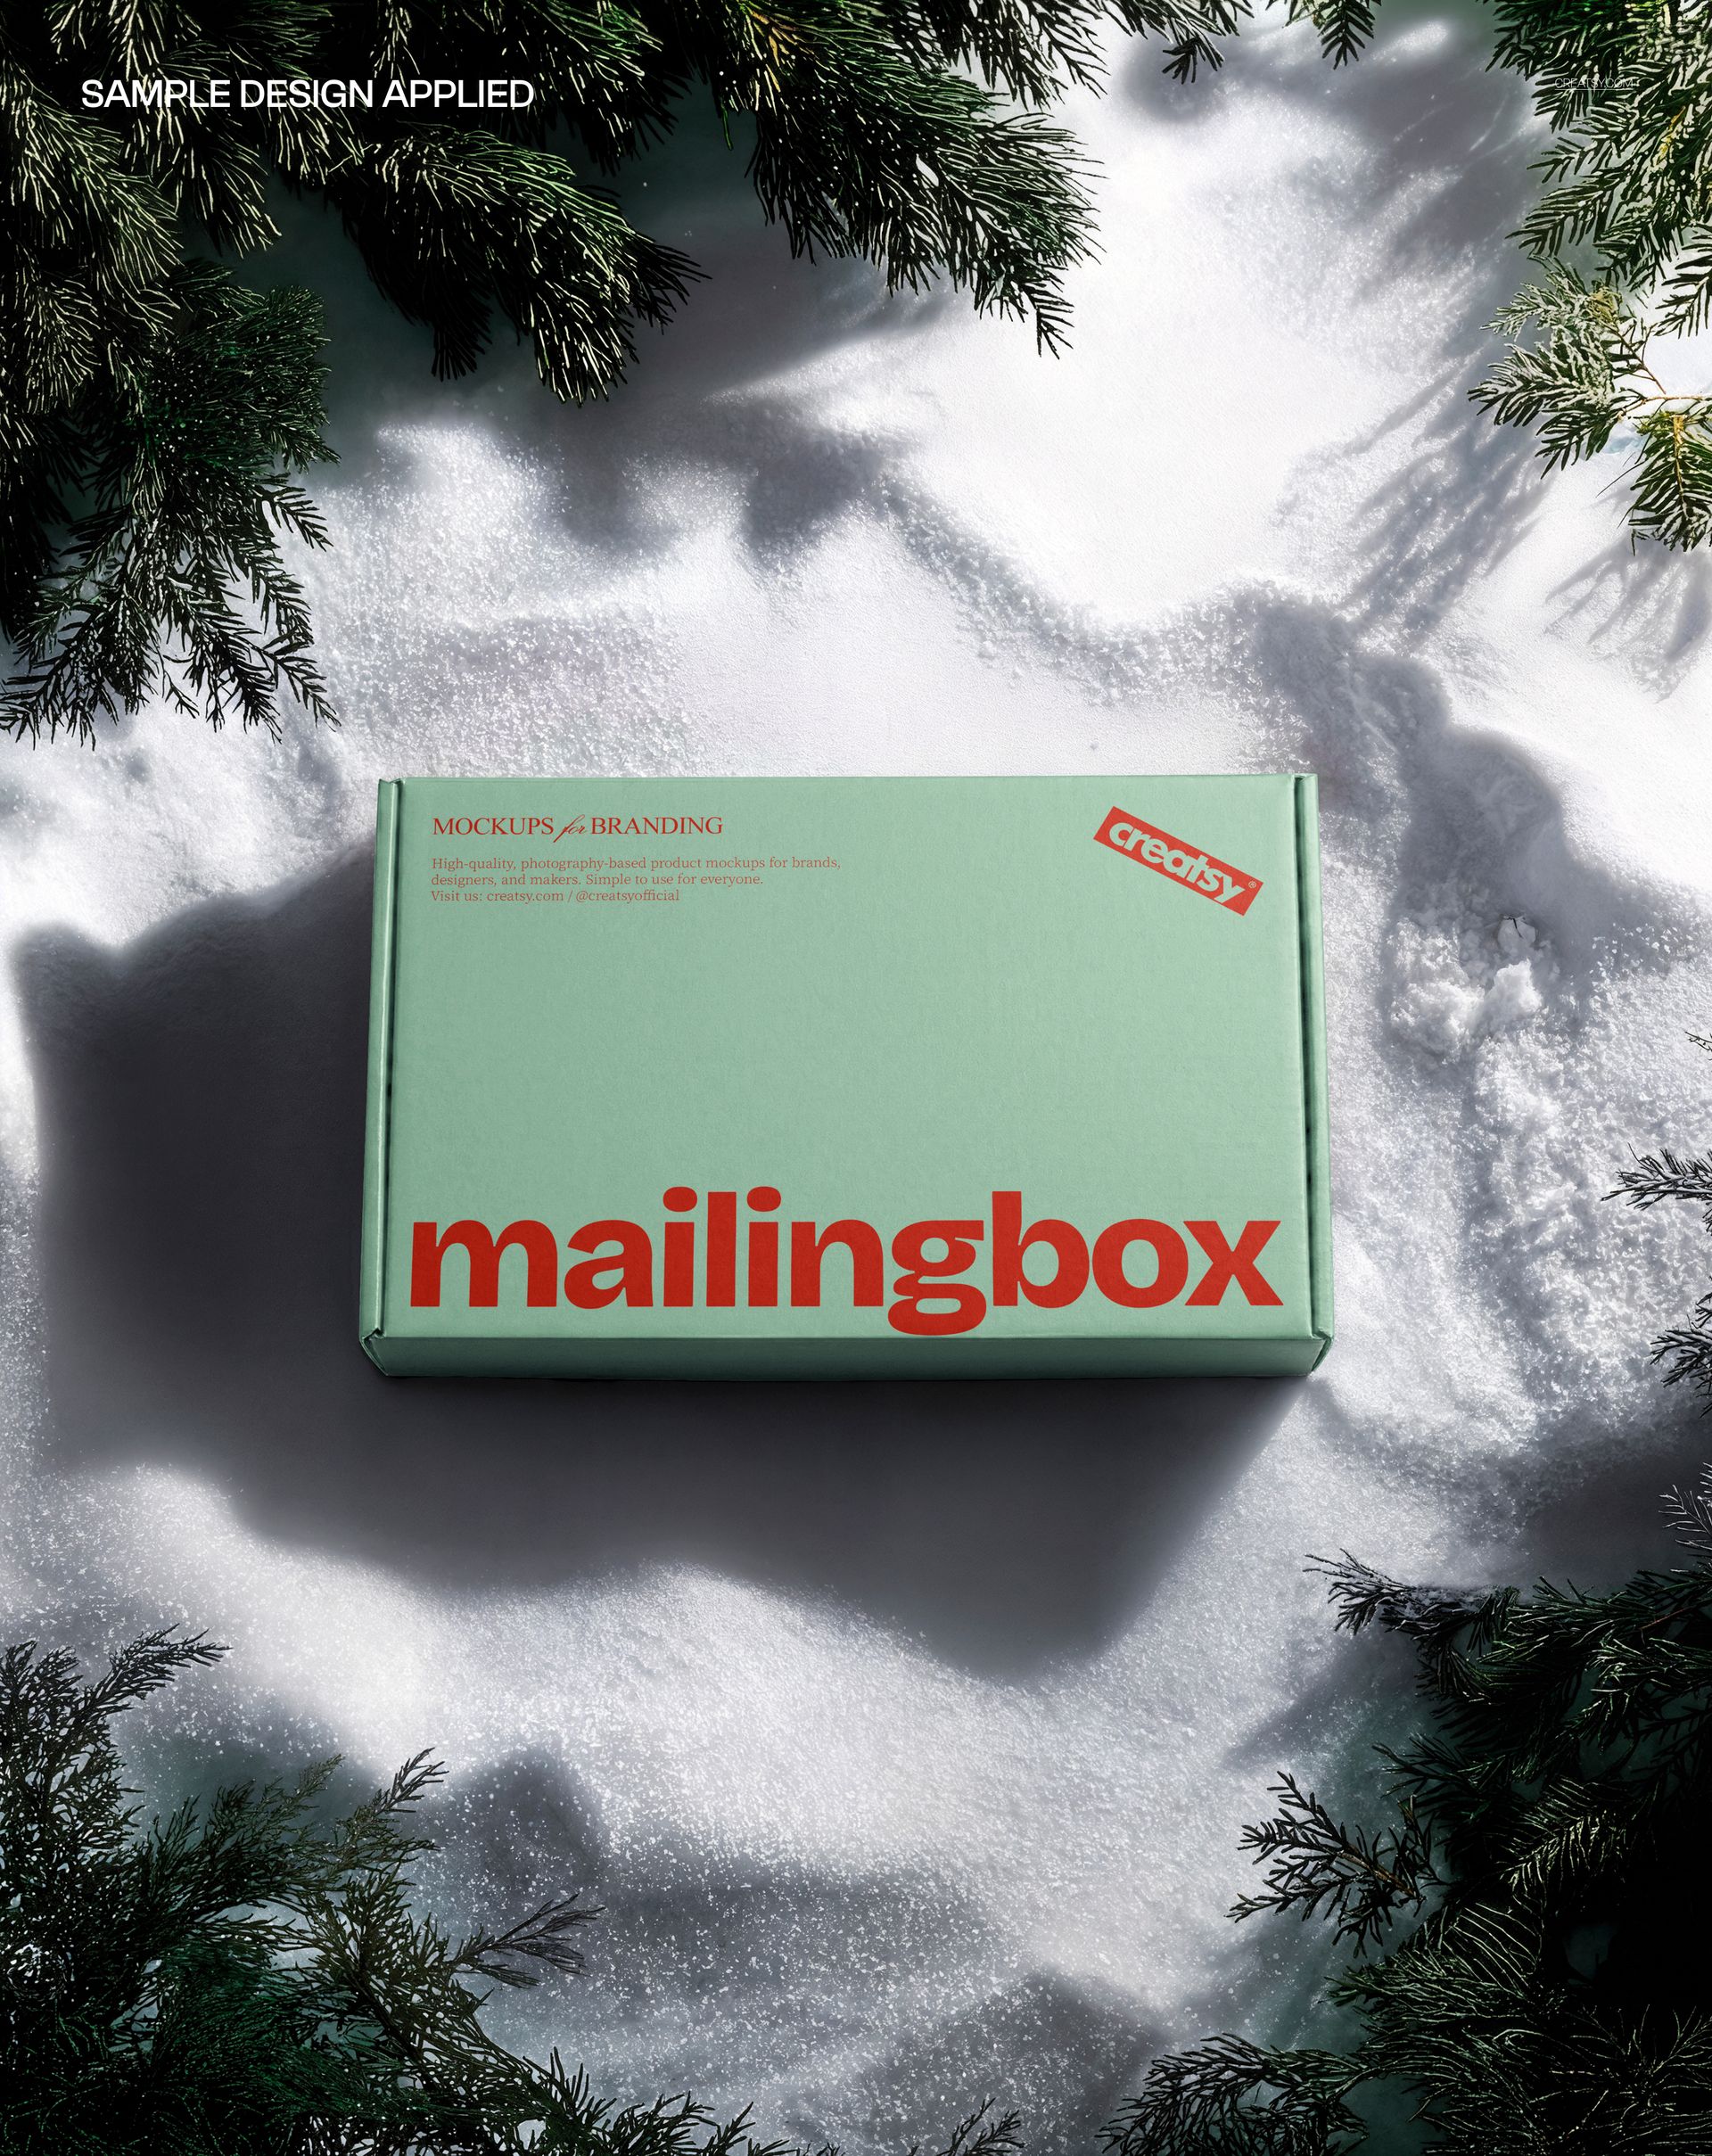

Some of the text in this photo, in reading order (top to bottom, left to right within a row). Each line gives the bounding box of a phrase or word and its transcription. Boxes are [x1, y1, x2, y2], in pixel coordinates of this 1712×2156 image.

[432, 813, 724, 843] MOCKUPS for BRANDING
[432, 856, 842, 872] High-quality, photography-based product mockups for brands,
[431, 873, 764, 888] designers, and makers. Simple to use for everyone.
[431, 889, 680, 904] Visit us: creatsy.com / @creatsyofficial
[409, 1186, 1284, 1337] mailingbox
